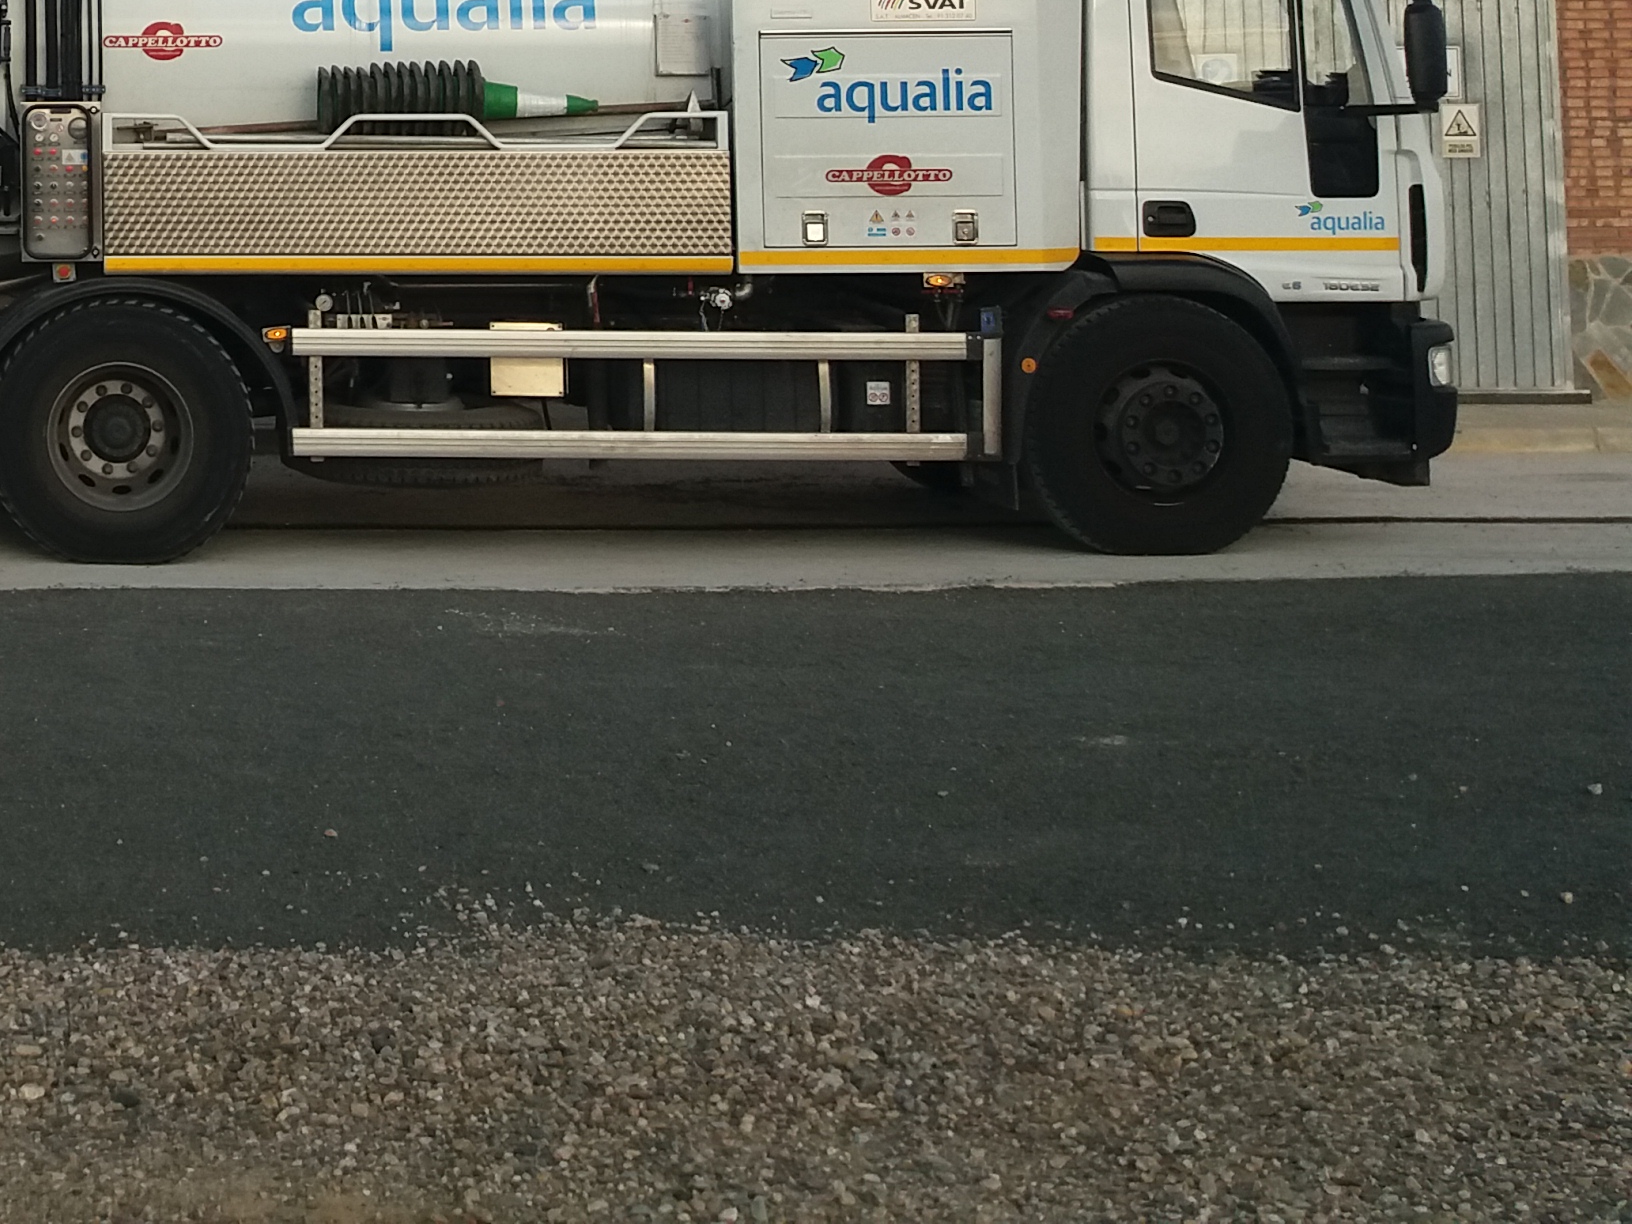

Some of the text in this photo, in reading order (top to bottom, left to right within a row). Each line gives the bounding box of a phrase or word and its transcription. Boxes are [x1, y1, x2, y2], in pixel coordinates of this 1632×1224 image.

[104, 36, 221, 47] CAPPELLOTTO
[817, 68, 993, 124] aqualia
[827, 170, 951, 181] CAPPELLOTTO
[1310, 211, 1385, 235] aqualia
